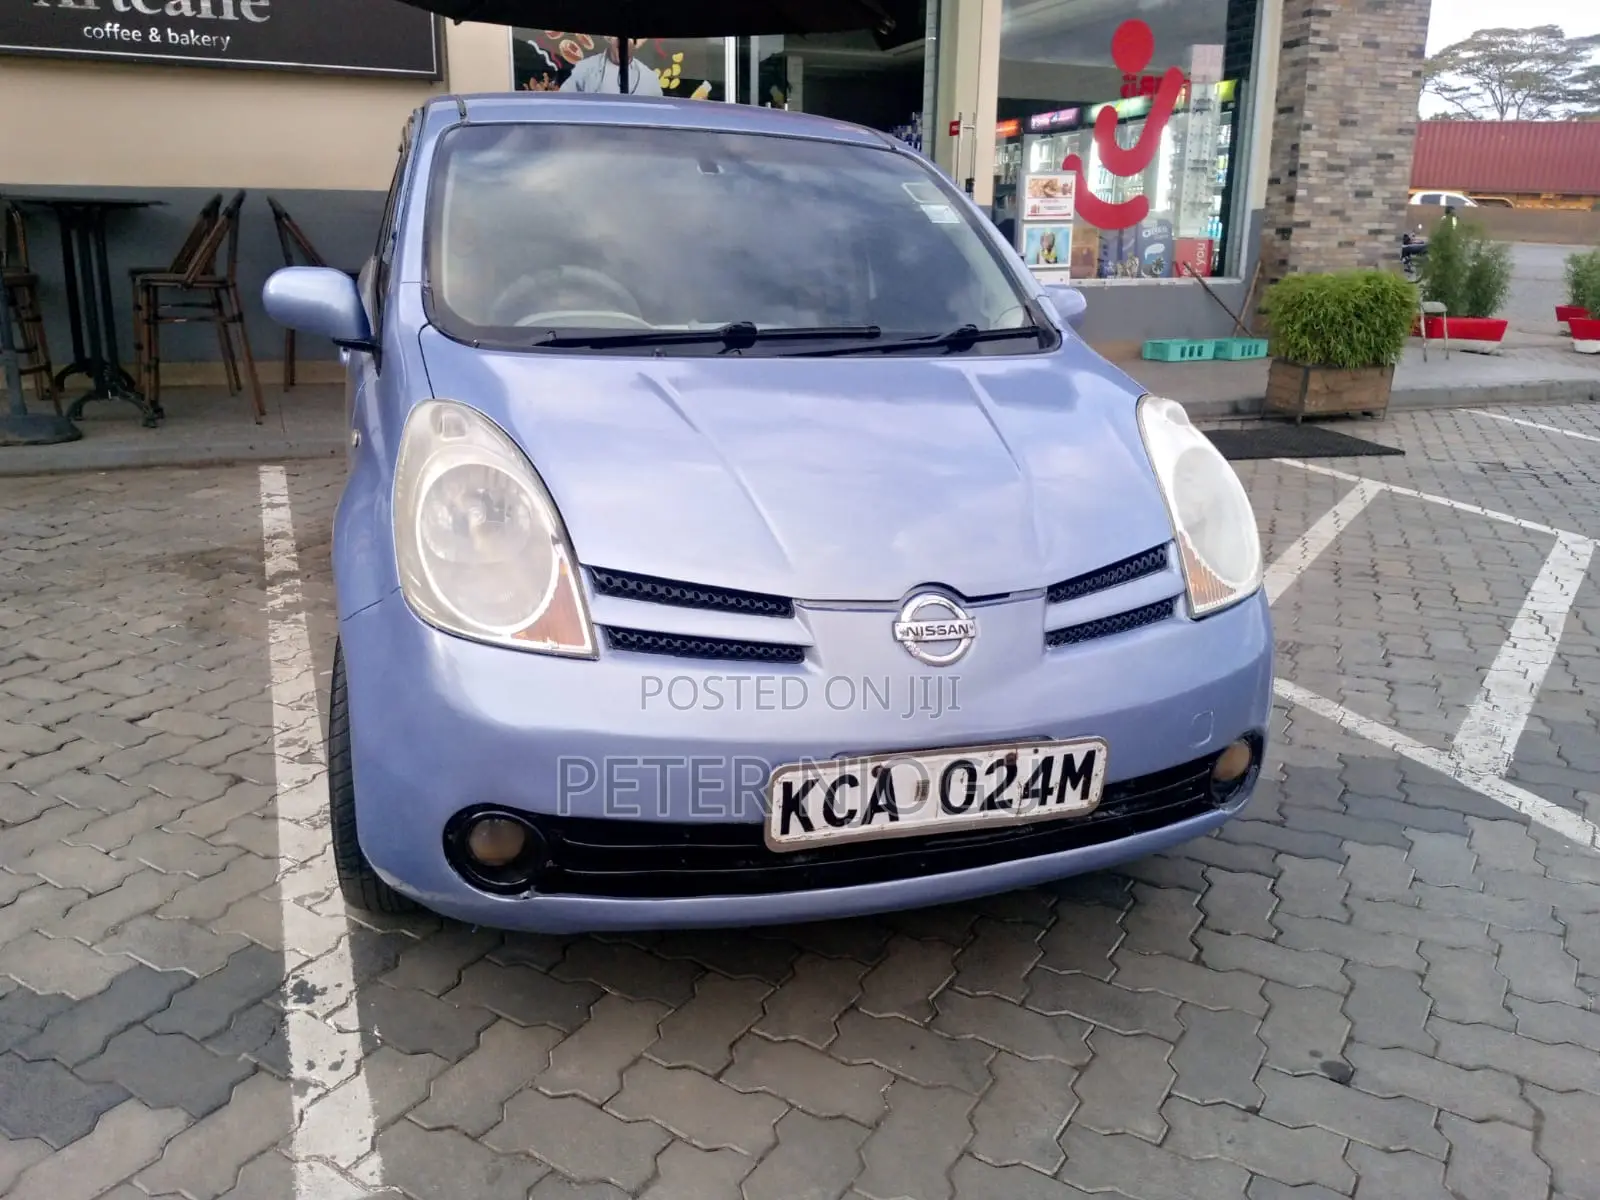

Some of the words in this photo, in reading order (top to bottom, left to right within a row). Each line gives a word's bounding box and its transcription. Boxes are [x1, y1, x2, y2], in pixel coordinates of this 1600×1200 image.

[83, 22, 142, 42] coffee
[148, 27, 162, 43] &
[167, 28, 231, 51] bakery
[905, 623, 969, 637] NISSAN
[780, 767, 900, 836] KCA
[939, 749, 1097, 816] 024M
